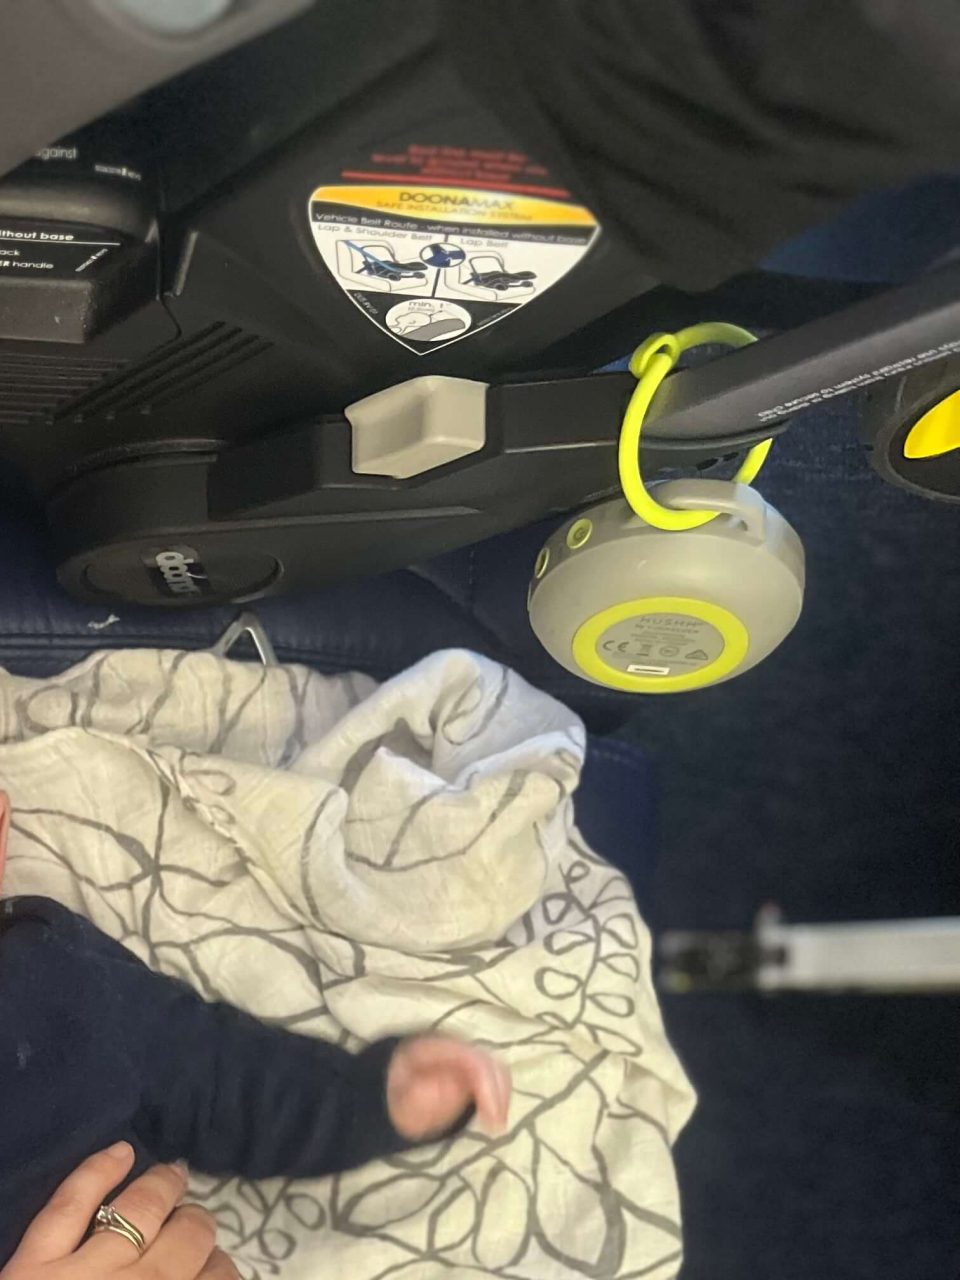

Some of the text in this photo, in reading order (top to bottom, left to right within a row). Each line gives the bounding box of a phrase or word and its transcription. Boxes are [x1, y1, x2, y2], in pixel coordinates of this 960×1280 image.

[400, 192, 513, 210] DOONAMAX
[316, 213, 358, 224] Vehicle
[360, 217, 381, 226] Belt
[383, 219, 418, 230] Route
[426, 224, 460, 234] when
[462, 227, 509, 239] installed
[512, 231, 555, 243] without
[556, 235, 587, 245] base
[318, 224, 433, 241] Lap & Shoulder Belt
[40, 232, 74, 241] base
[460, 238, 483, 247] Lap
[12, 261, 54, 269] handle
